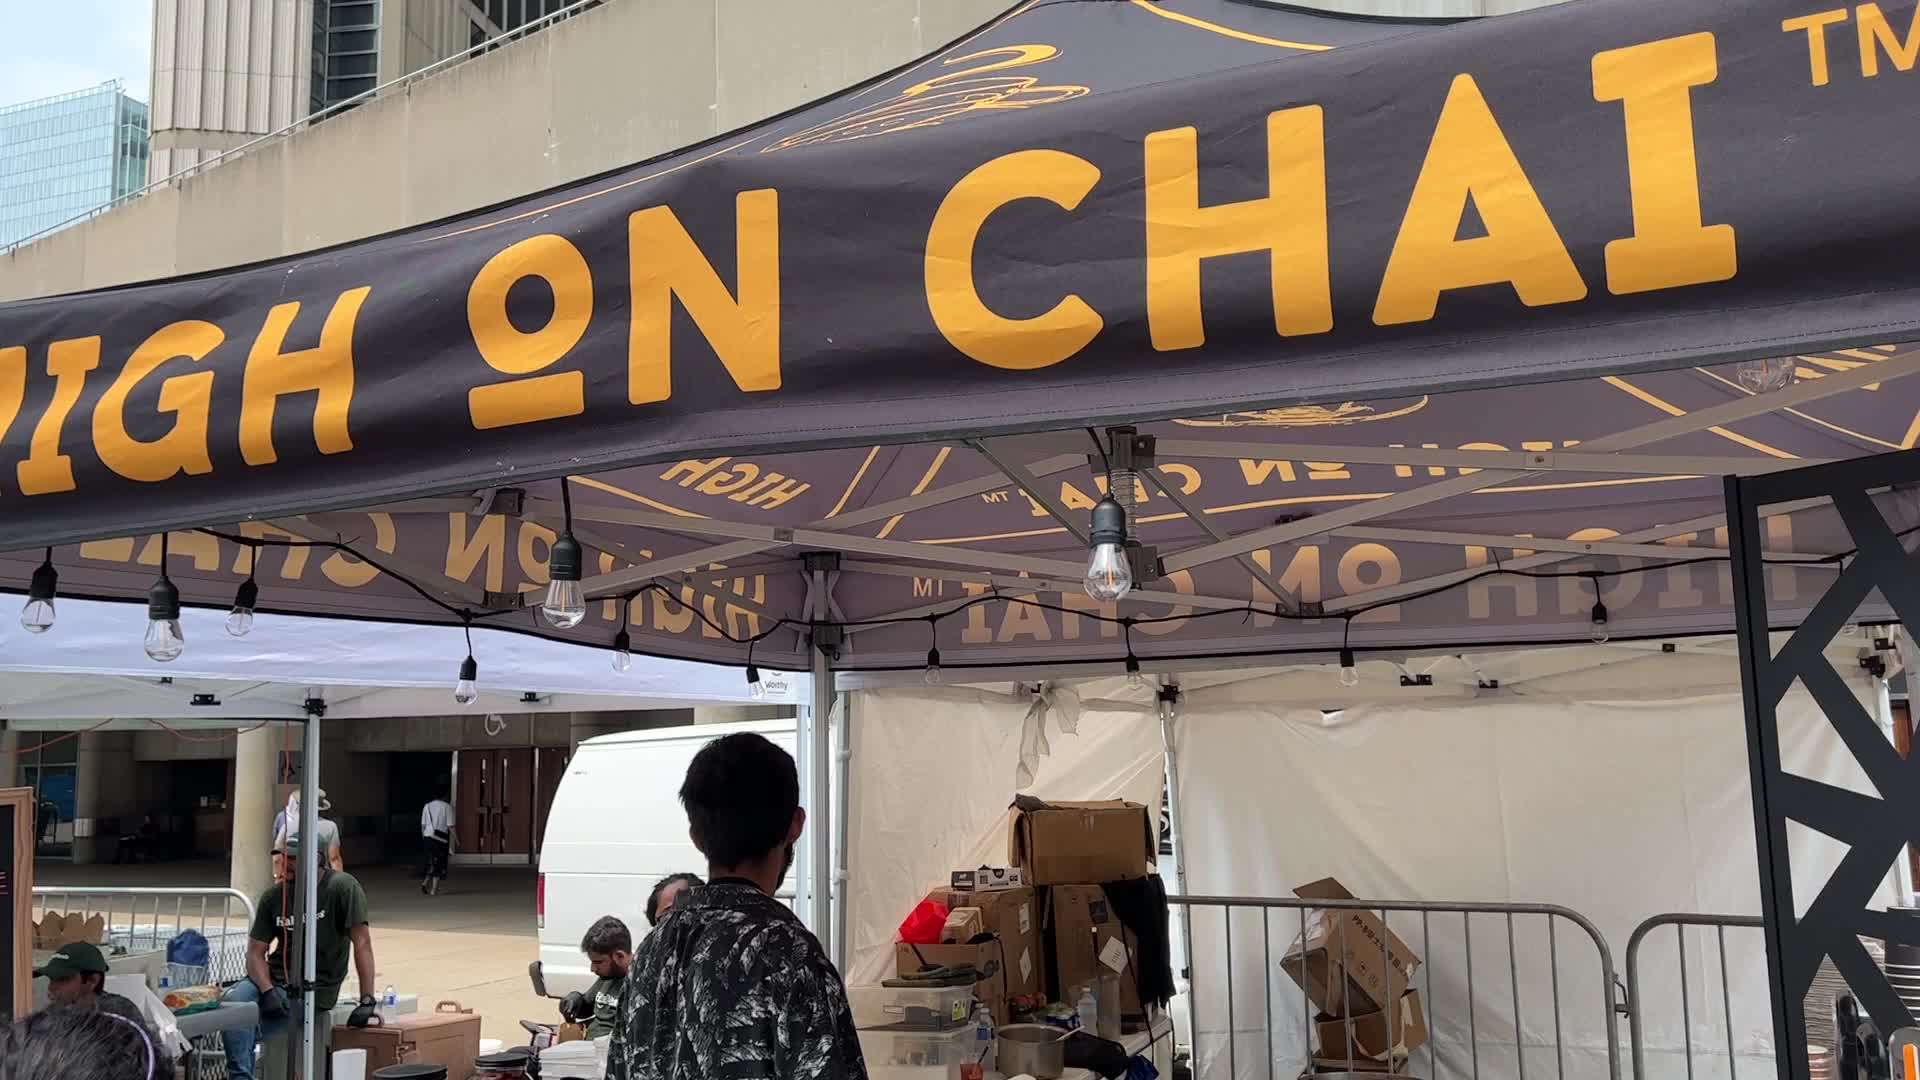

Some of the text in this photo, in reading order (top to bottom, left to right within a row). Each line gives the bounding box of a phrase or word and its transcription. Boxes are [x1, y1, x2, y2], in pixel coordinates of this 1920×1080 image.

[0, 286, 371, 496] IGH
[467, 188, 782, 430] ON
[923, 31, 1738, 370] CHAI
